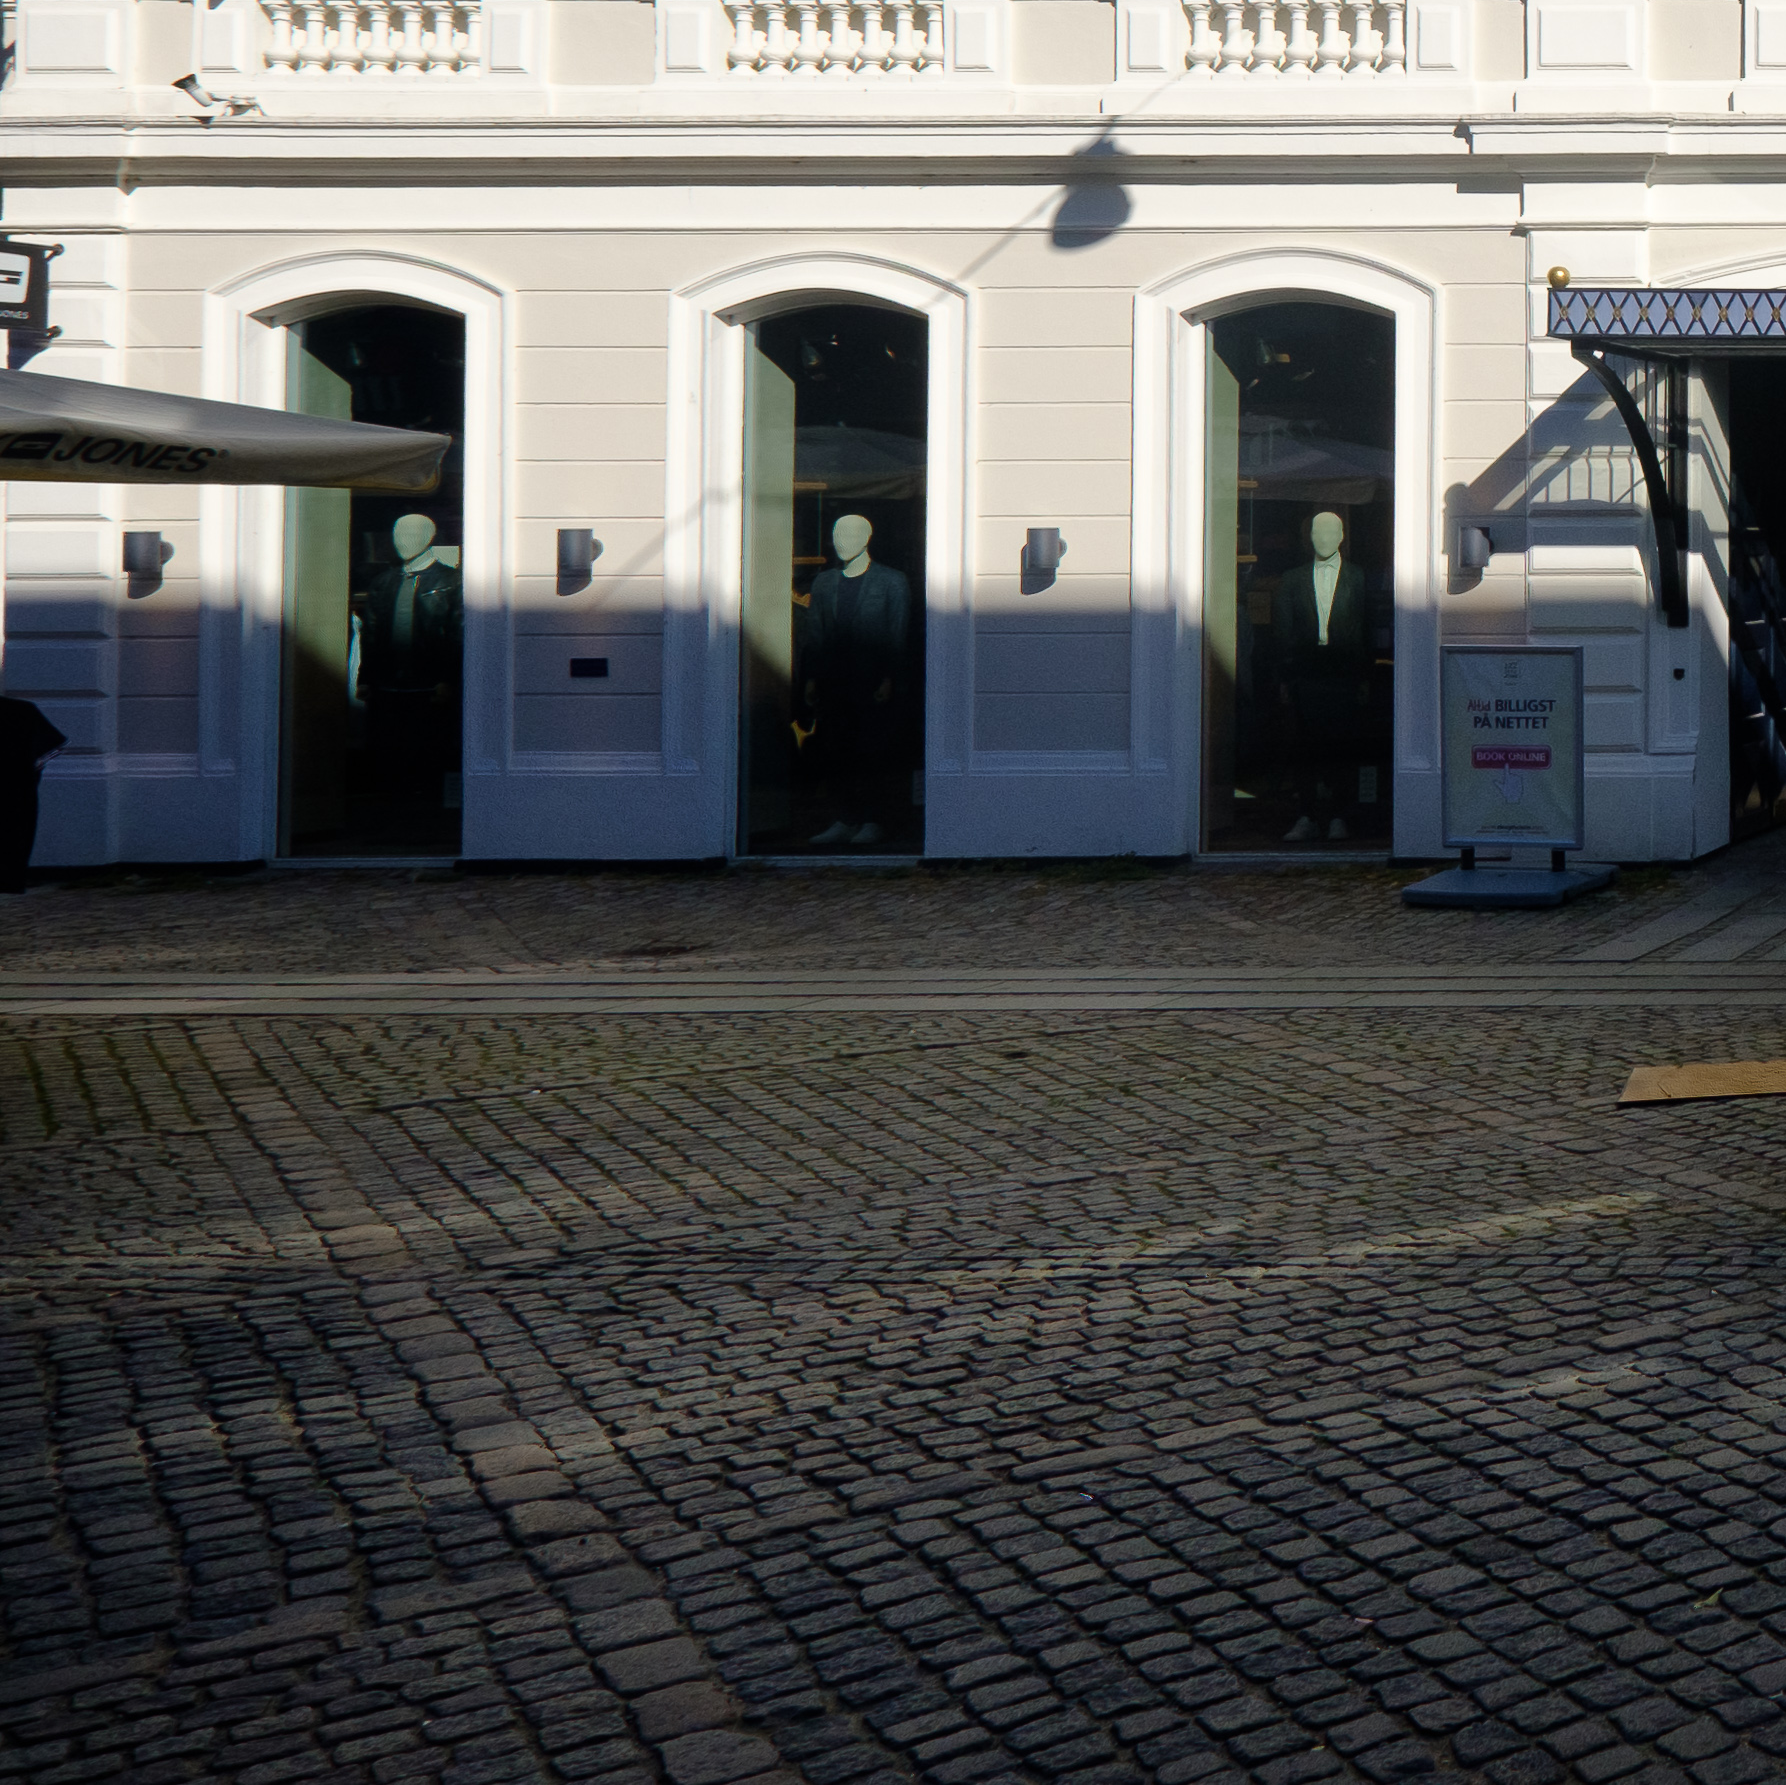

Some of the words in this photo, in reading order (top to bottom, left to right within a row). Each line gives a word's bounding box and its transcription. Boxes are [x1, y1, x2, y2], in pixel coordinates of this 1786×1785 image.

[1494, 698, 1557, 713] BILLIGST
[1473, 712, 1492, 729] PÅ
[1494, 715, 1550, 729] NETTET
[1475, 751, 1506, 762] BOOK
[1508, 751, 1546, 763] ONLINE
